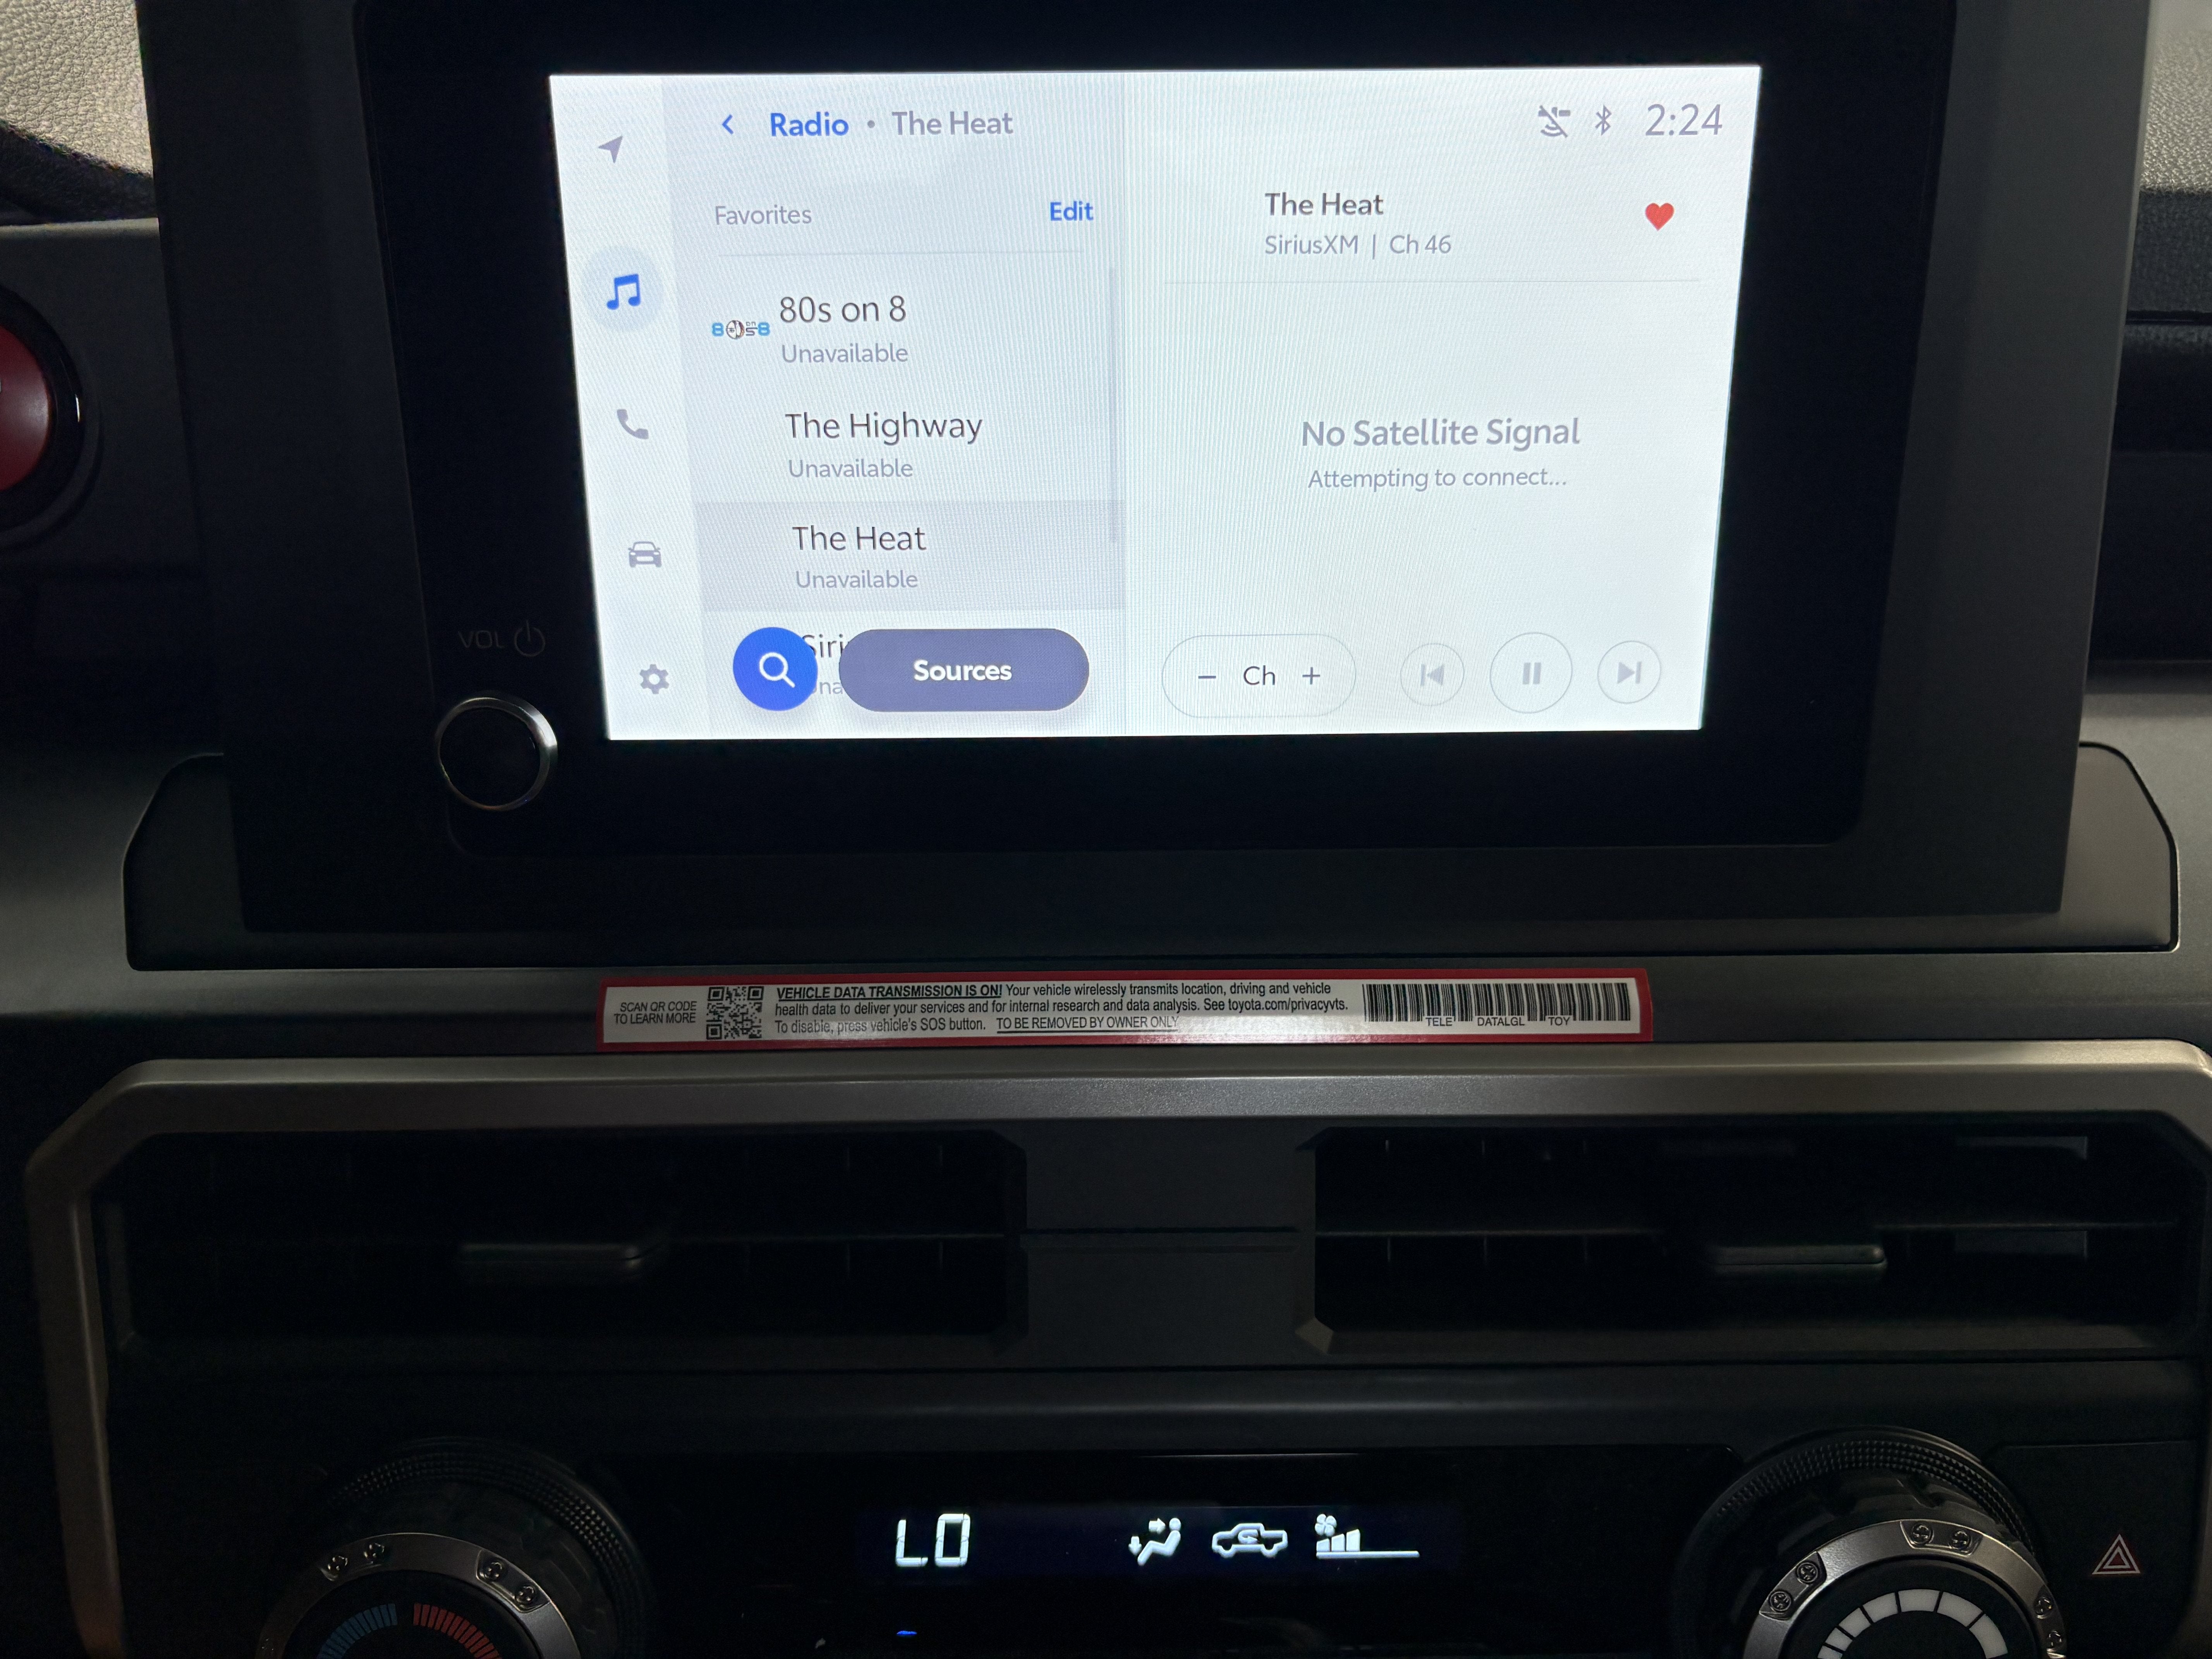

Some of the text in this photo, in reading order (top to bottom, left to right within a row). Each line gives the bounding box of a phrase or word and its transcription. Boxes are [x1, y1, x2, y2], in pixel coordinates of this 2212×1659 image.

[771, 111, 1013, 136] Radio The Heat
[1646, 104, 1722, 136] 2:24
[1050, 201, 1092, 220] Edit
[1266, 192, 1382, 215] The Heat
[715, 204, 811, 225] Favorites
[1266, 235, 1358, 254] SiriusXM
[1390, 234, 1419, 254] Ch
[1425, 235, 1451, 253] 46
[780, 295, 906, 323] 80s on 8
[782, 343, 908, 363] Unavailable
[785, 412, 982, 445] The Highway
[1303, 418, 1580, 451] No Satellite Signal
[788, 459, 913, 477] Unavailable
[1309, 469, 1566, 492] Attempting to connect...
[793, 526, 925, 551] The Heat
[796, 570, 917, 588] Unavailable
[457, 630, 505, 649] VOL
[914, 660, 1012, 680] Sources
[1243, 665, 1275, 685] Ch
[777, 982, 1331, 999] VEHICLE DATA TRANSMISSION IS ON! Your vehicle wirelessly transmits location, driving and vehicle
[620, 1001, 697, 1012] SCAN QR CODE
[775, 998, 1348, 1017] health data to deliver your services and for internal research and data analysis. See toyota.com/privacyvts.
[614, 1013, 696, 1024] TO LEARN MORE
[775, 1016, 1179, 1035] To disable, press vehicle's SOS button. TO BE REMOVED BY OWNER ONLY
[1425, 1017, 1570, 1026] TELE DATALGL TOY
[896, 1513, 970, 1566] LO
